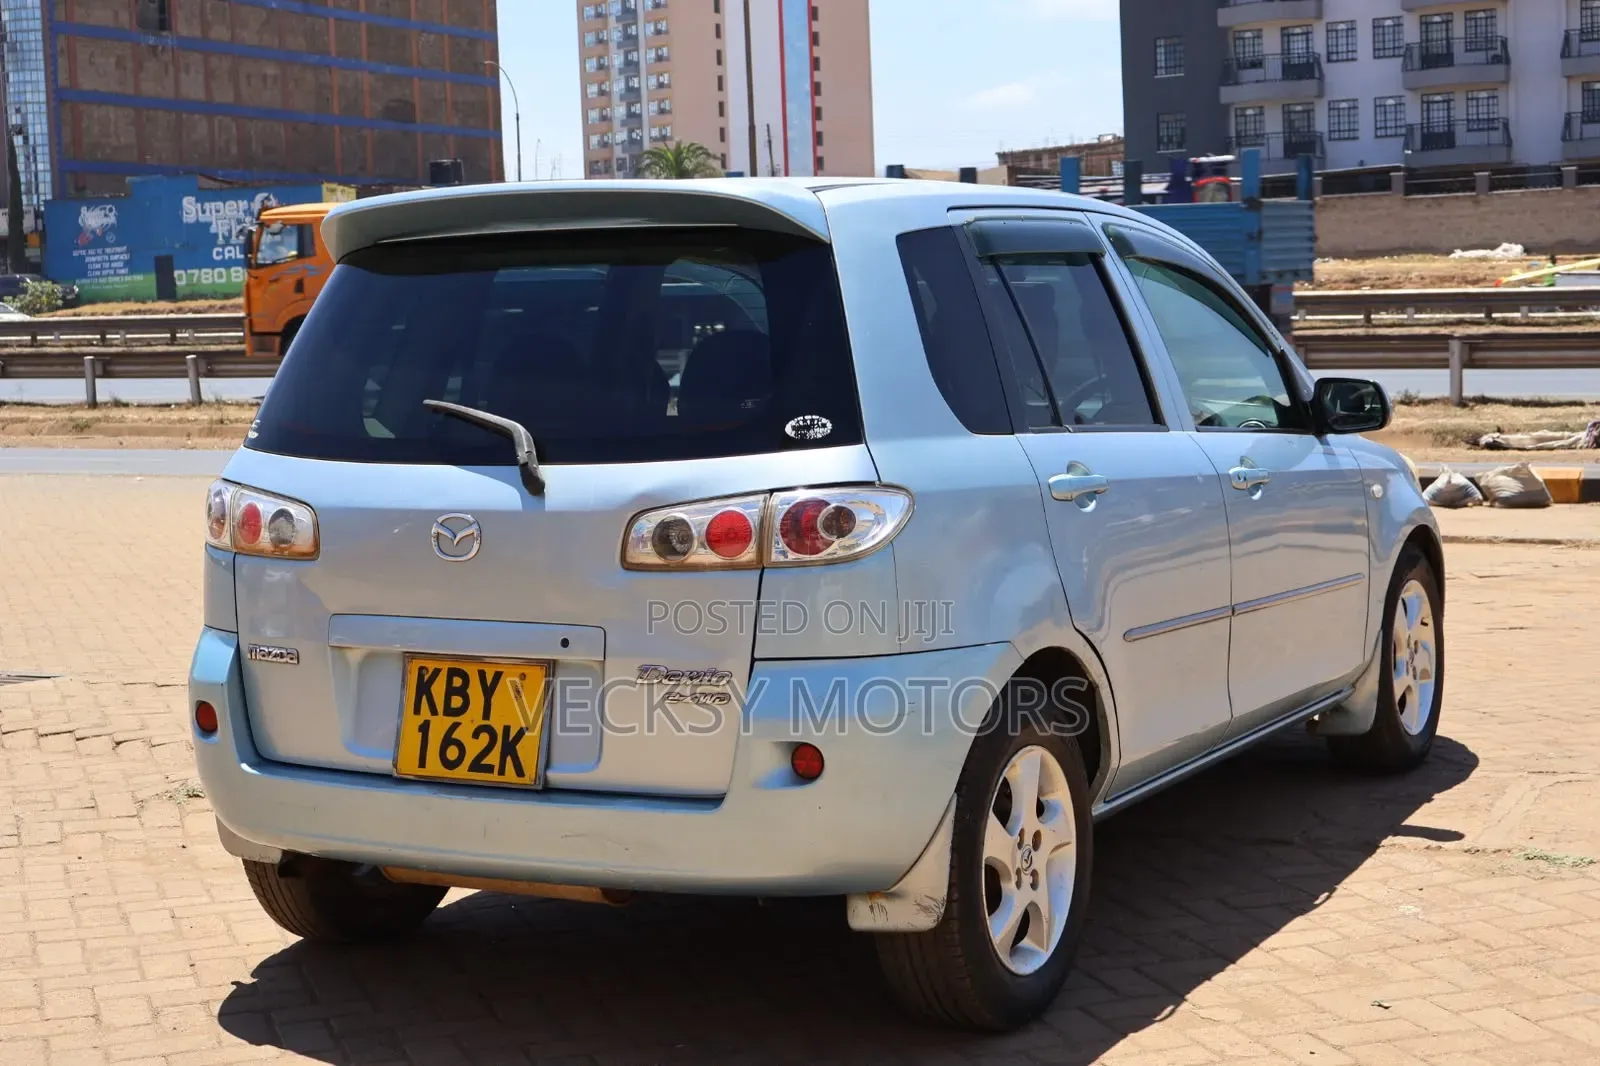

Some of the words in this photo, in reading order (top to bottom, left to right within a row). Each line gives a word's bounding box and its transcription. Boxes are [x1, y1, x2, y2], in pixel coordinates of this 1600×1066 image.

[182, 196, 249, 224] Super
[174, 267, 227, 286] 0780
[636, 664, 733, 687] Demio
[413, 665, 505, 721] KBY
[417, 719, 529, 778] 162K
